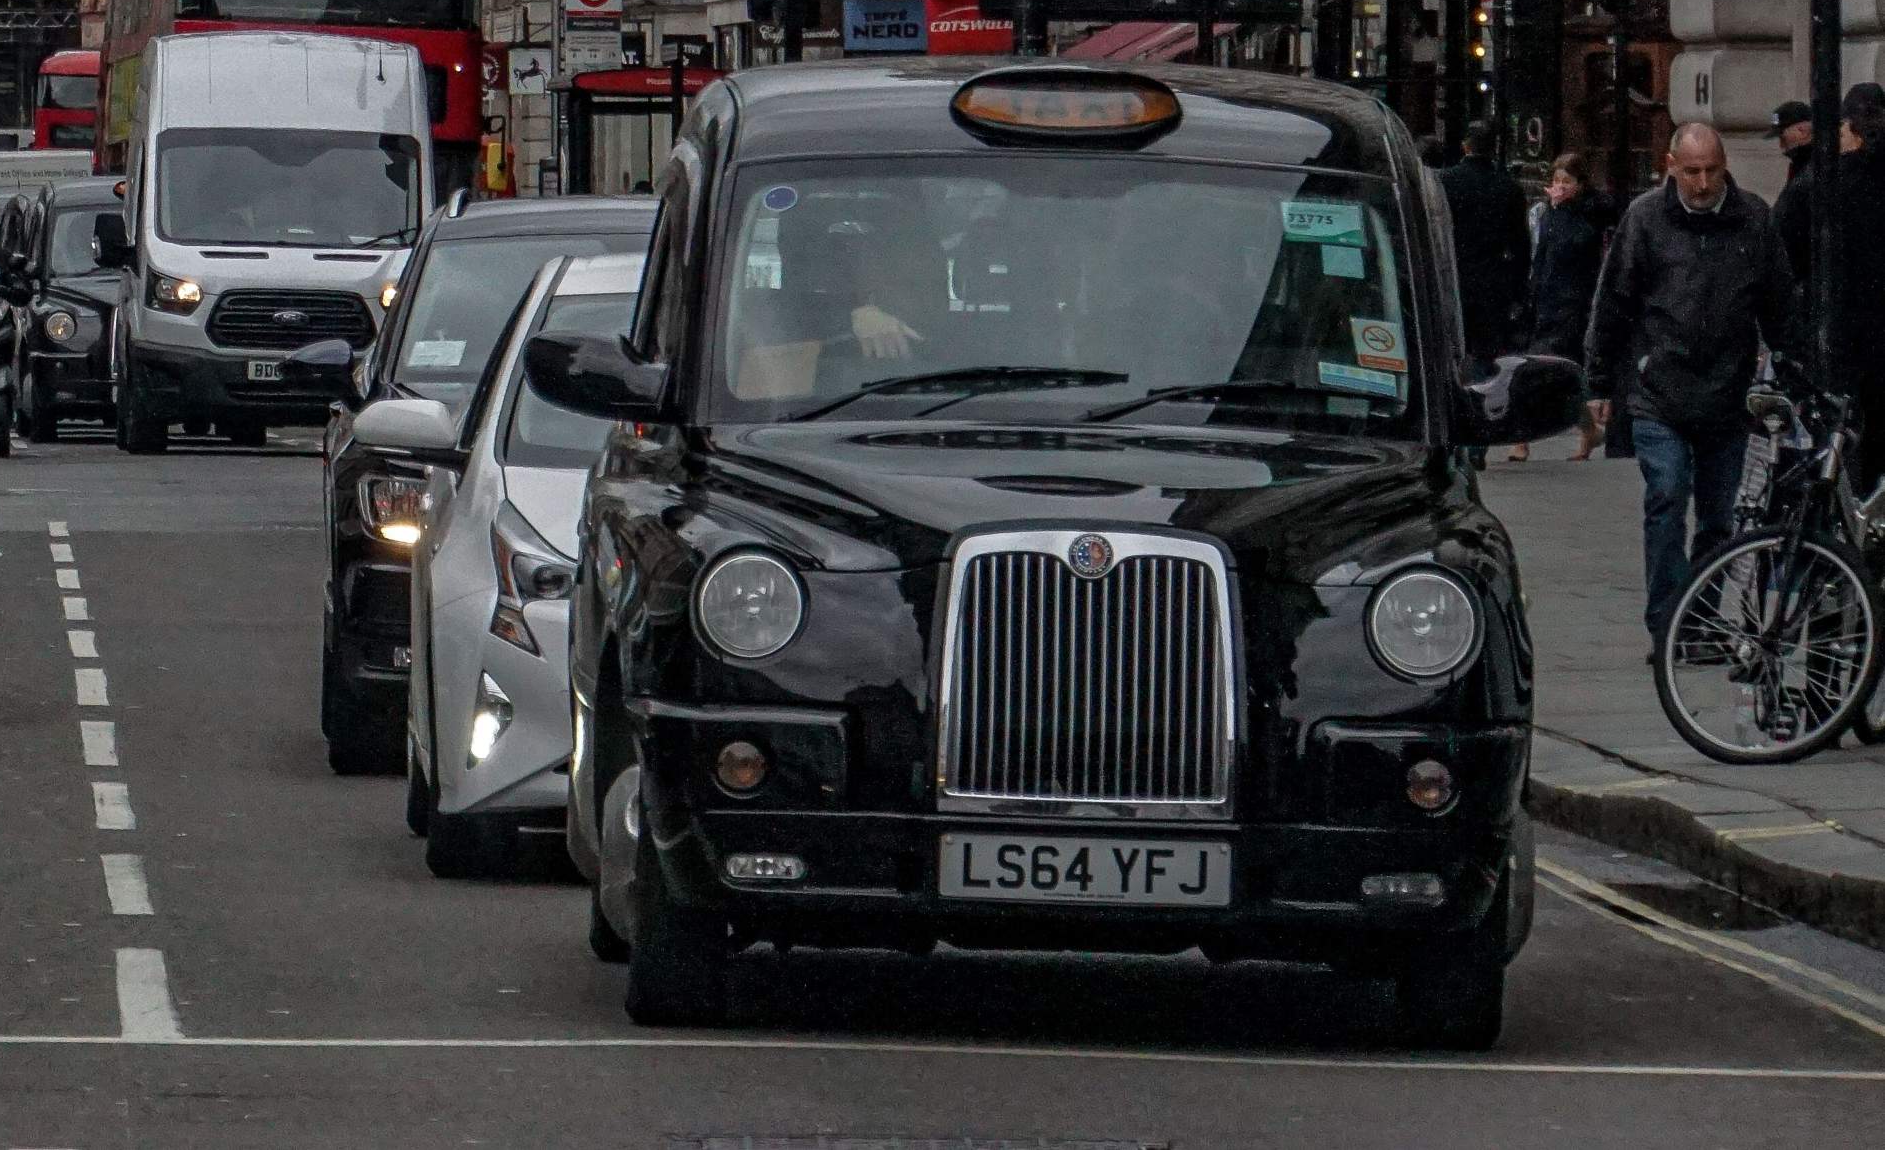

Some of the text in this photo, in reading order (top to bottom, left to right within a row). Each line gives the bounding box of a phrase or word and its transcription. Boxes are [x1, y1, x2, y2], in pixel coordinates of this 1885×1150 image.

[853, 24, 919, 38] NERO
[962, 842, 1209, 896] LS64 YFJ
